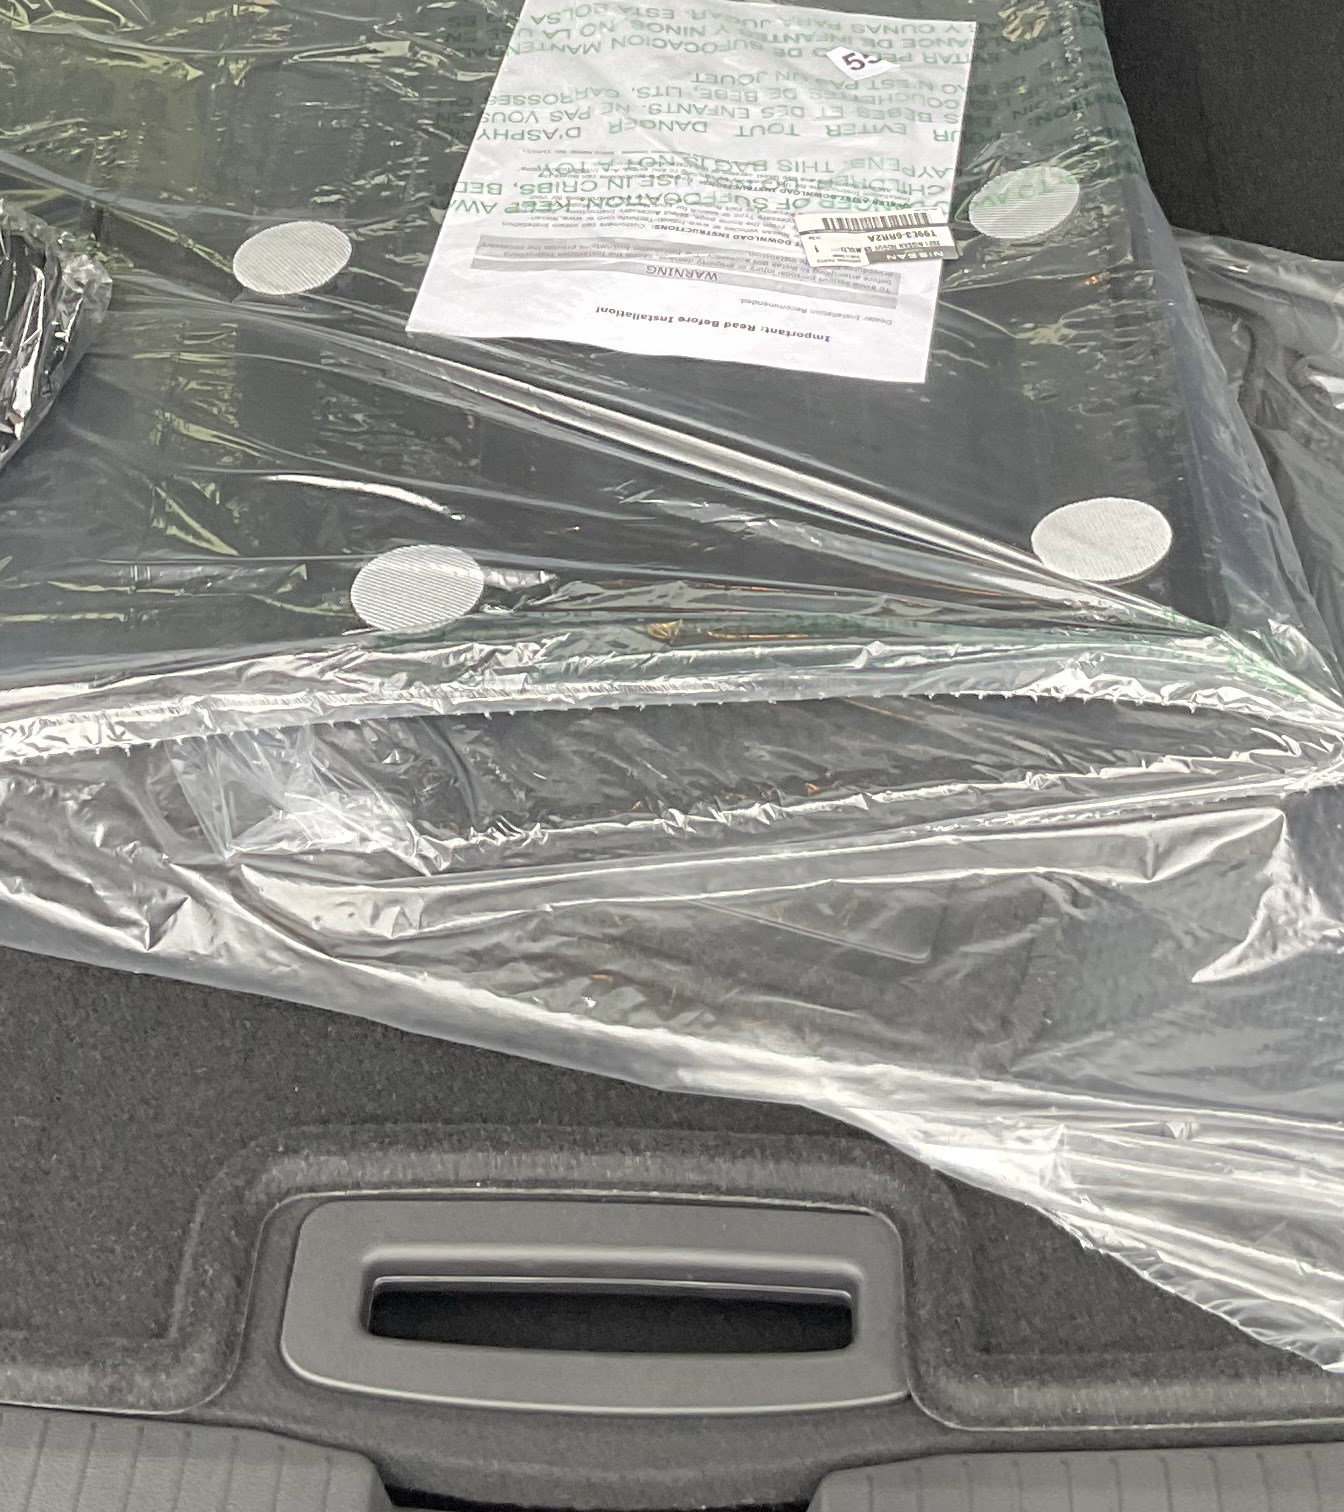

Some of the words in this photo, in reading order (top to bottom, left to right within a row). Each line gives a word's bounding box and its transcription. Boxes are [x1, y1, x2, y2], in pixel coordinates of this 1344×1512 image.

[542, 27, 571, 41] LA
[580, 20, 615, 37] NO
[850, 22, 935, 36] CUNAS
[610, 35, 763, 56] SUFOCACION
[772, 47, 802, 58] DE
[767, 86, 798, 102] DE
[548, 105, 591, 122] PAS
[641, 102, 750, 119] ENFANTS.
[760, 105, 804, 120] DES
[734, 123, 800, 138] TOUT
[826, 123, 907, 137] EVITER
[714, 159, 768, 172] BAG
[777, 159, 835, 174] THIS
[513, 180, 598, 196] CRIBS,
[607, 177, 631, 190] IN
[776, 197, 811, 211] OF
[733, 234, 792, 246] DOWNLOAD
[886, 250, 944, 261] NISSAN
[645, 265, 718, 282] WARNING
[595, 305, 674, 324] Installation!
[677, 315, 720, 328] Before
[810, 308, 860, 322] Installation
[863, 315, 893, 326] Dealer
[723, 320, 756, 332] Read
[760, 325, 830, 343] Important:
